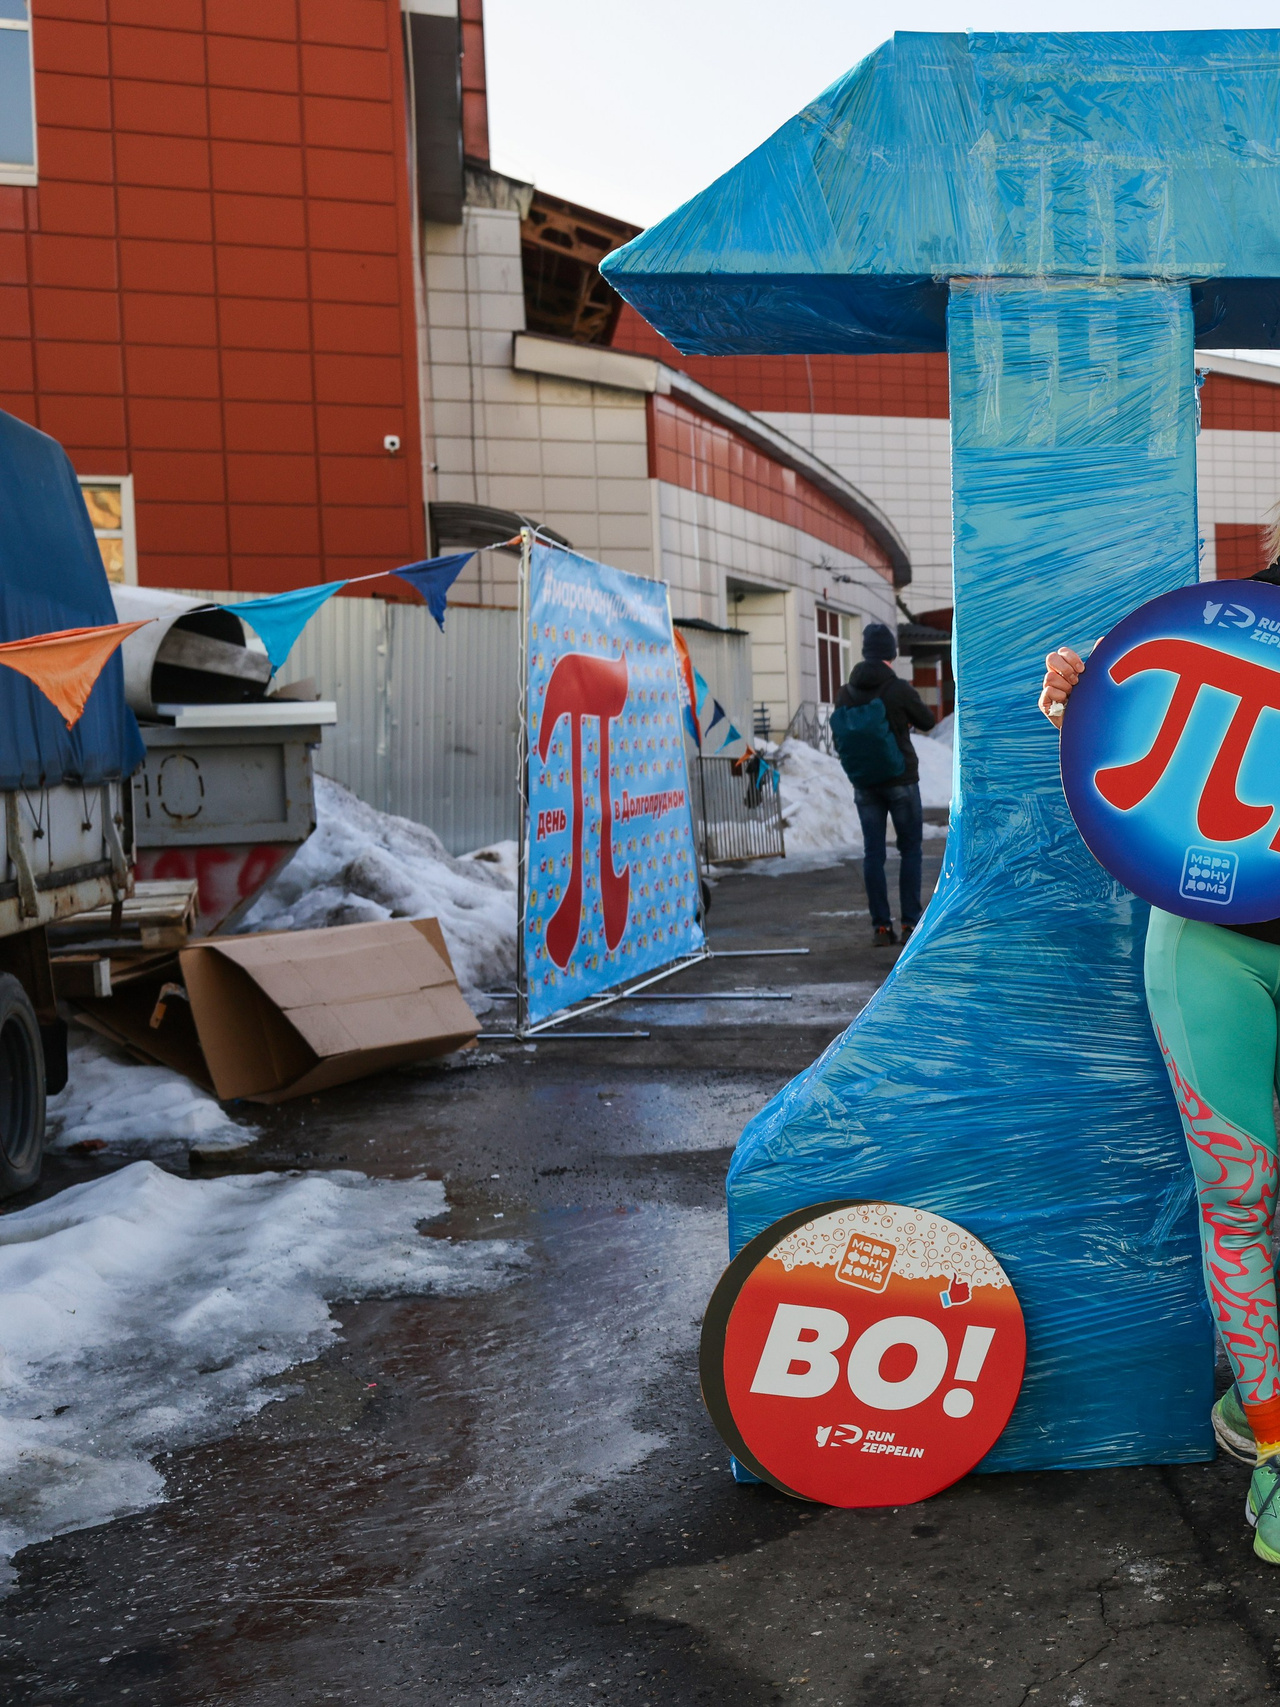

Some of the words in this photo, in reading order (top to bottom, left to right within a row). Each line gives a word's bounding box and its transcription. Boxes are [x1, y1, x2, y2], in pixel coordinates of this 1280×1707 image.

[536, 808, 567, 842] день
[614, 800, 621, 821] в
[621, 788, 685, 824] Долгопрудном
[1191, 853, 1231, 870] мара
[1188, 866, 1231, 884] фону
[1185, 878, 1227, 895] дома
[851, 1237, 891, 1259] мара
[847, 1250, 889, 1271] фону
[841, 1263, 883, 1284] дома
[749, 1302, 997, 1419] ВО!
[865, 1429, 896, 1443] RUN
[860, 1442, 924, 1458] ZEPPELIN
